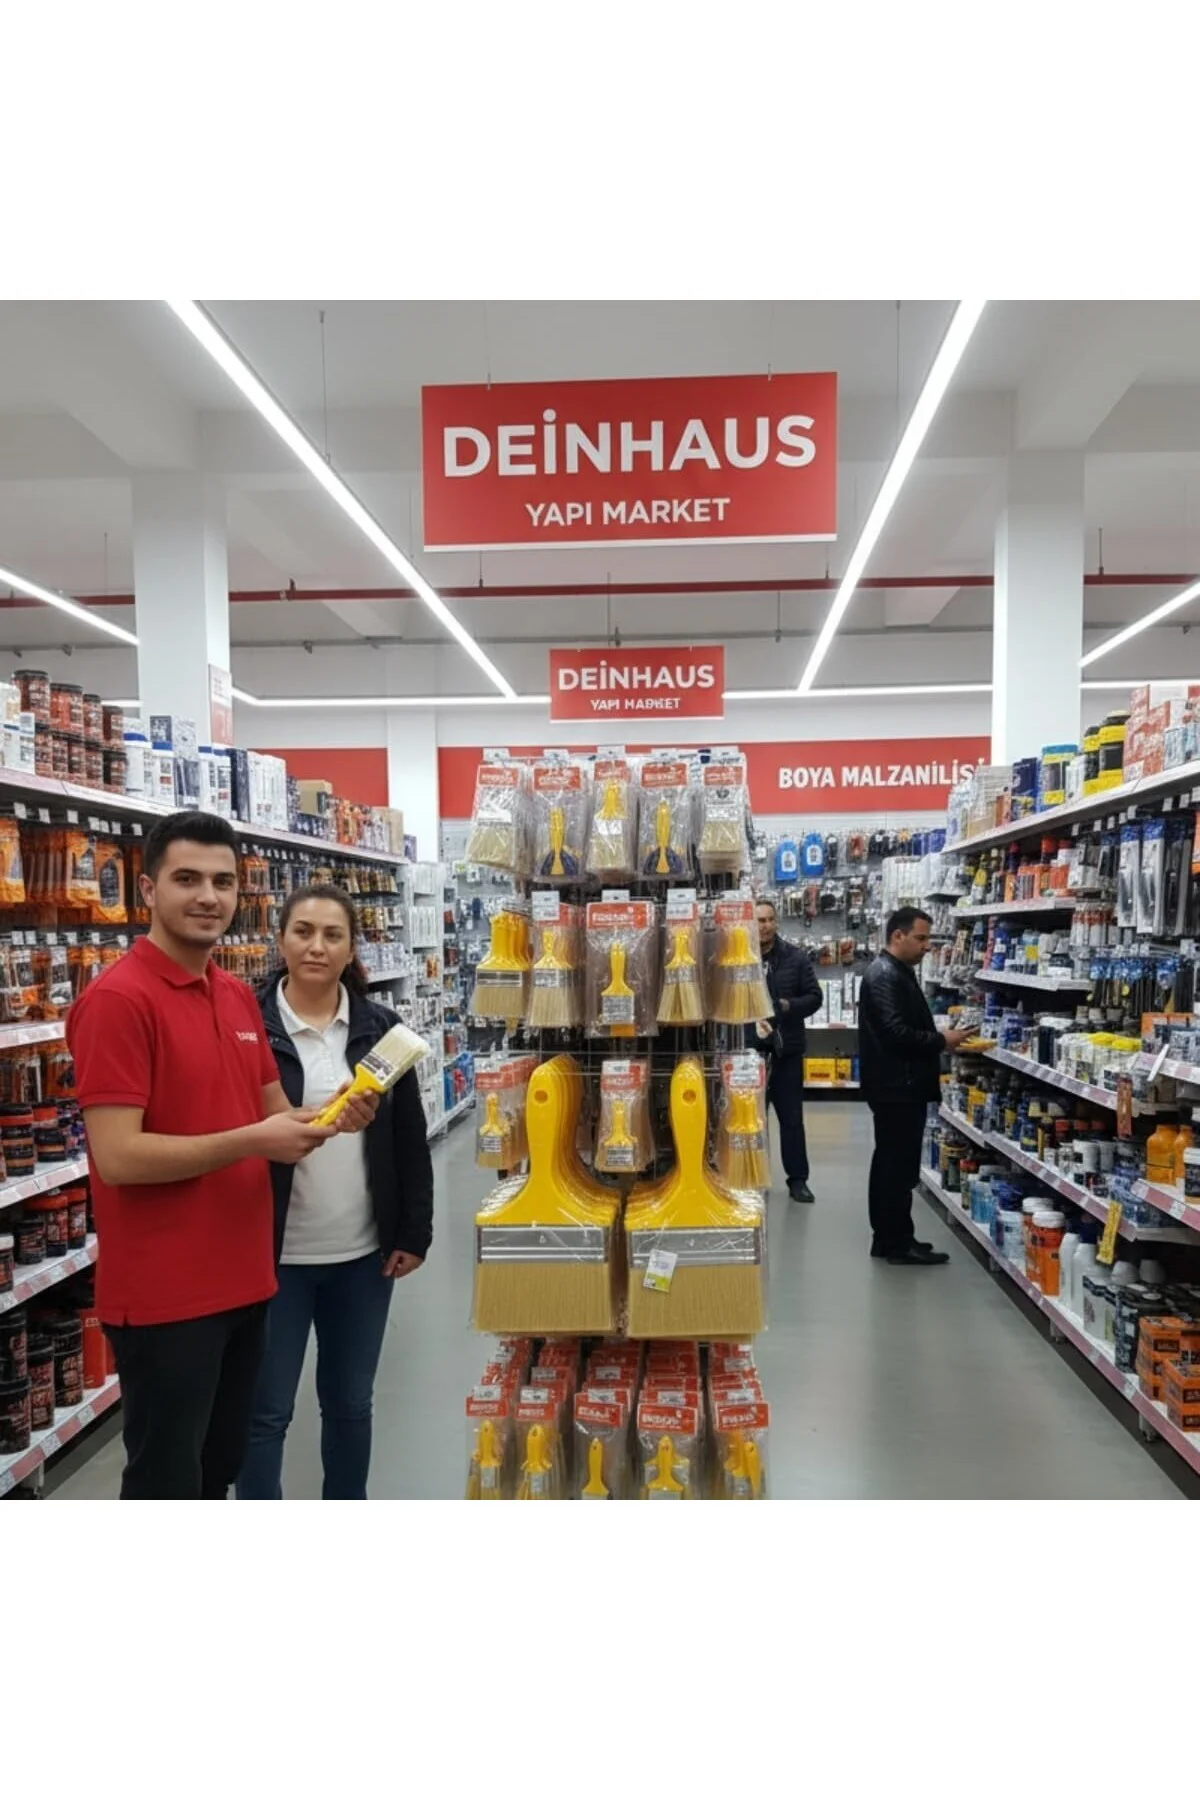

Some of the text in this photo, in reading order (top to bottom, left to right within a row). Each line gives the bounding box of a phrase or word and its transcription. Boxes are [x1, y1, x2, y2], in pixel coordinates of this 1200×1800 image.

[525, 497, 731, 527] YAPI MARKET
[590, 698, 620, 711] YAPI
[778, 757, 984, 789] BOYA MALZANİLİS
